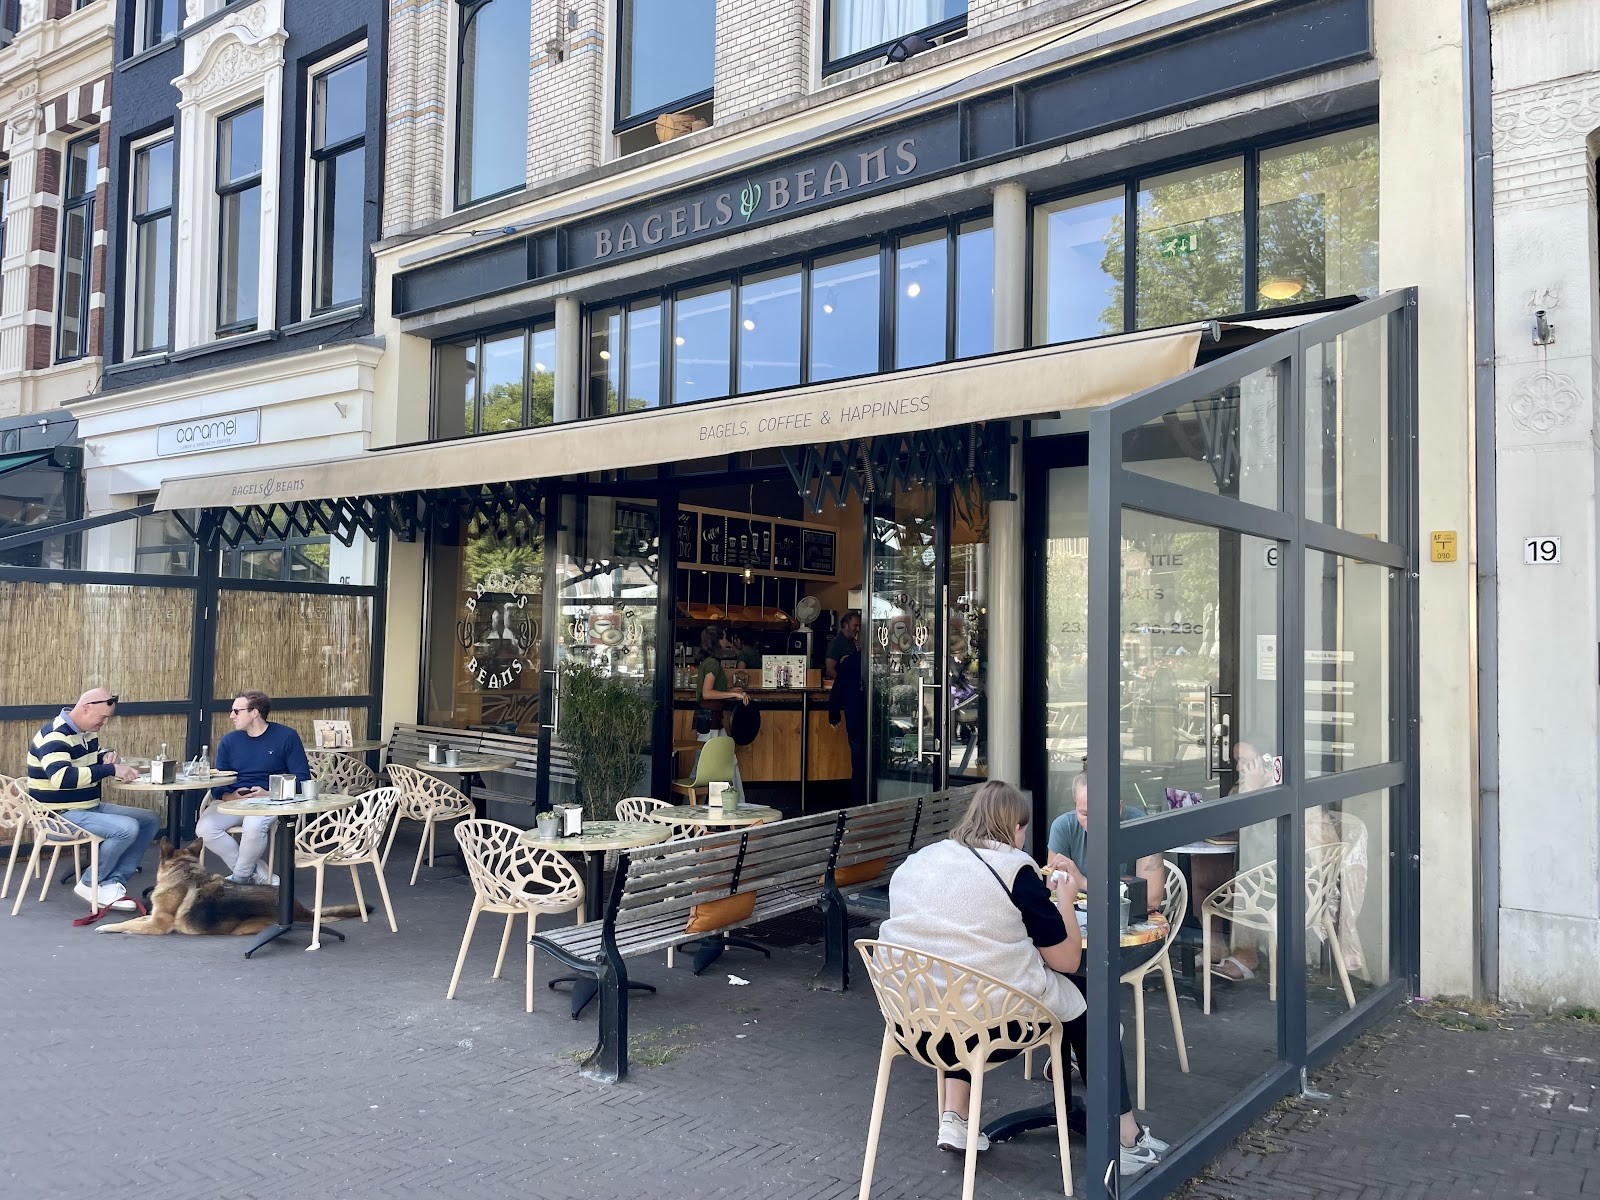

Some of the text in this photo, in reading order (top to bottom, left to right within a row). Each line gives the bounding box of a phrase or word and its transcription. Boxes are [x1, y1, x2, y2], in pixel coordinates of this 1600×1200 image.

[594, 193, 734, 260] BAGELS
[767, 138, 918, 213] BEANS
[176, 416, 237, 443] caramel
[699, 395, 931, 441] BAGELS, COFFEE & HAPPINESS
[231, 483, 263, 496] BAGELS
[275, 479, 305, 492] BEANS
[1527, 540, 1557, 562] 19
[466, 573, 528, 613] BAGELS
[466, 656, 522, 689] BEANS
